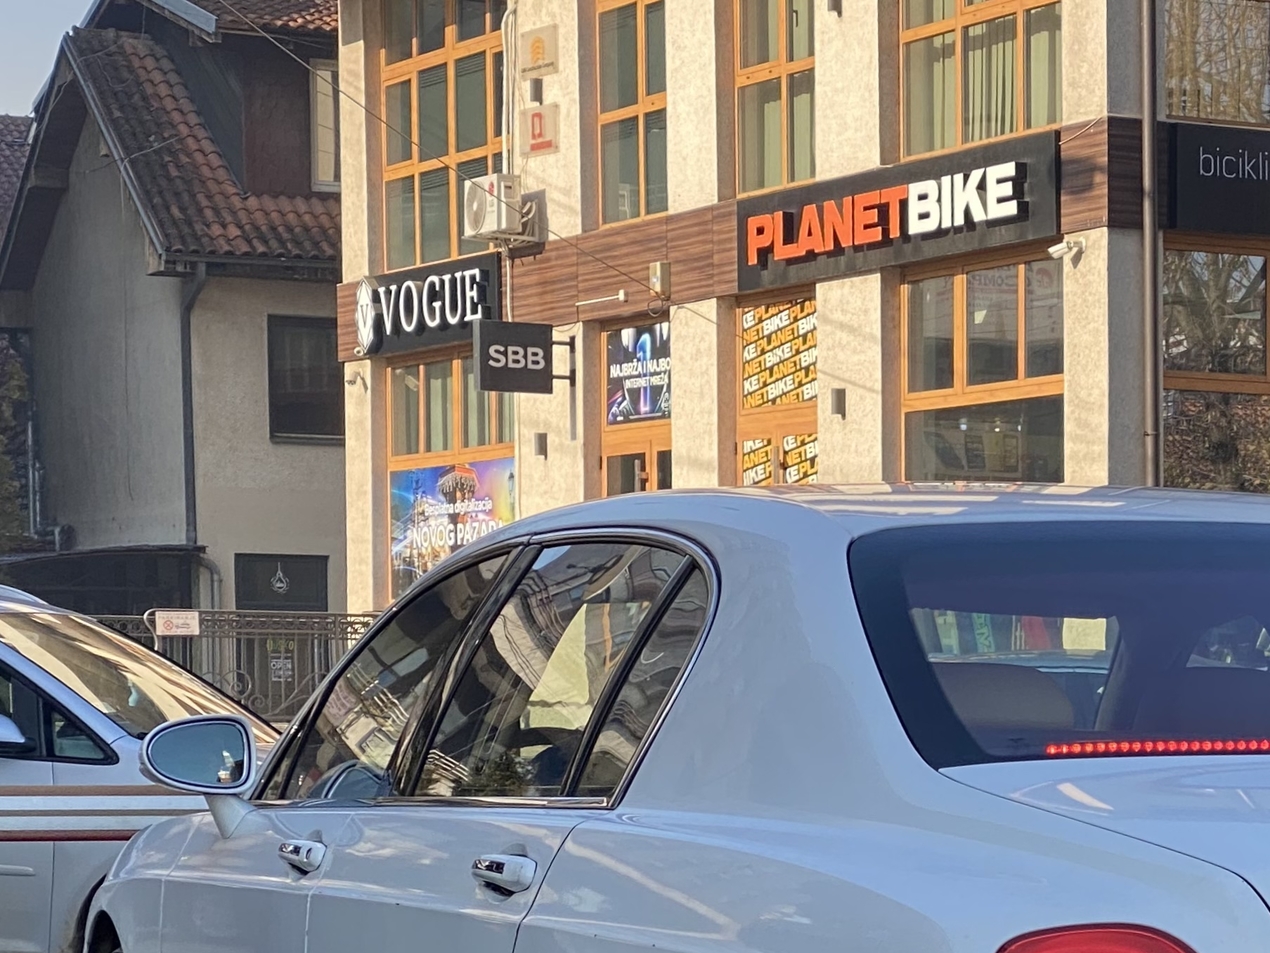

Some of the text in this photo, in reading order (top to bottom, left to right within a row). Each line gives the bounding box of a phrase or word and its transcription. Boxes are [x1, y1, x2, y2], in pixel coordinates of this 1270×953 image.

[1199, 147, 1269, 180] bicikli
[747, 161, 1018, 266] PLANETBIKE
[377, 267, 483, 336] VOGUE
[488, 344, 546, 370] SBB
[424, 496, 493, 517] Besplatna digitalizacija
[412, 523, 455, 549] NOVOG
